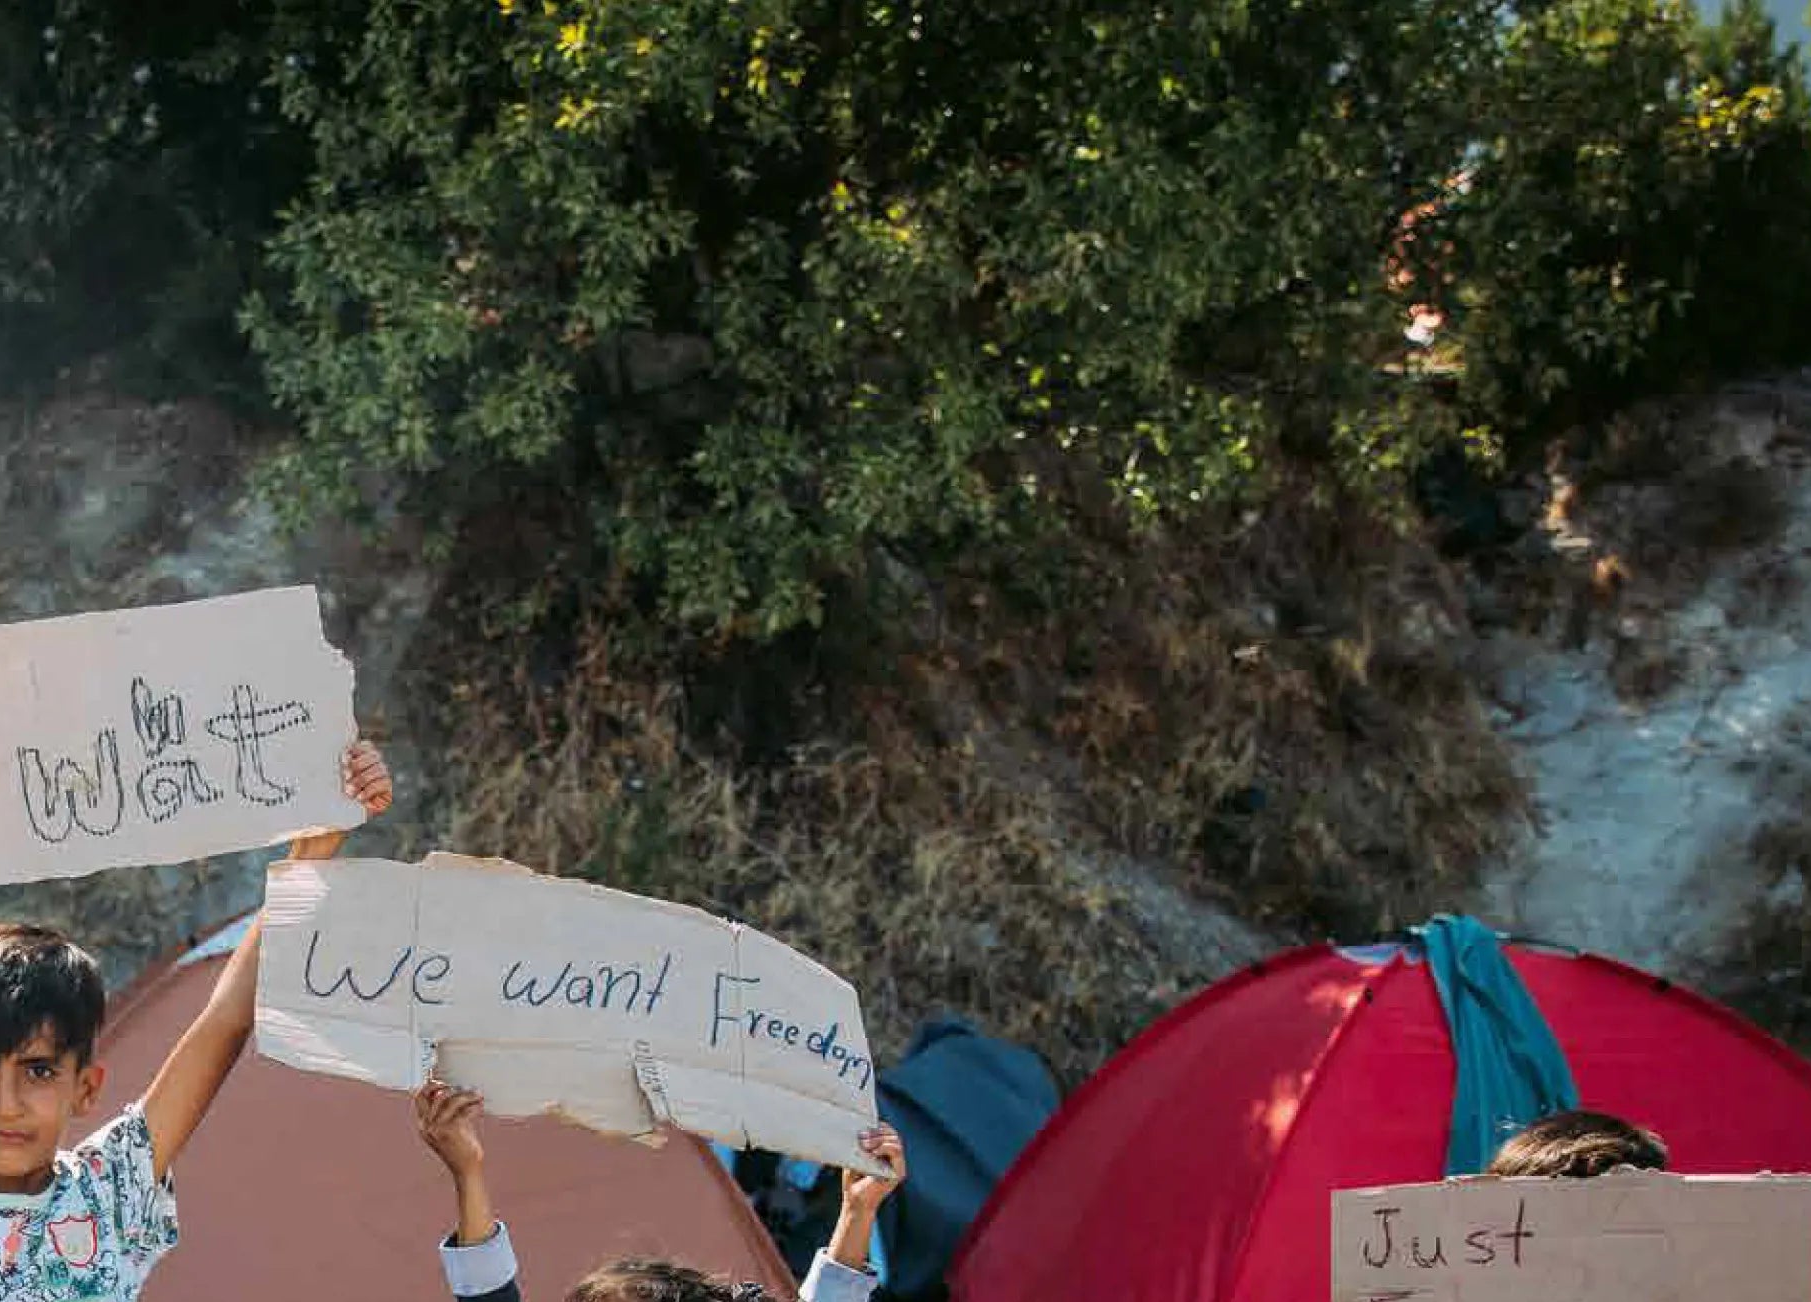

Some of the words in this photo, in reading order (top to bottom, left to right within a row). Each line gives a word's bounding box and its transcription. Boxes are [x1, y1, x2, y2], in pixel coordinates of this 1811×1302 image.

[304, 929, 453, 1005] We
[501, 951, 672, 1015] want
[710, 972, 873, 1091] Freedom
[1361, 1198, 1535, 1268] Just
